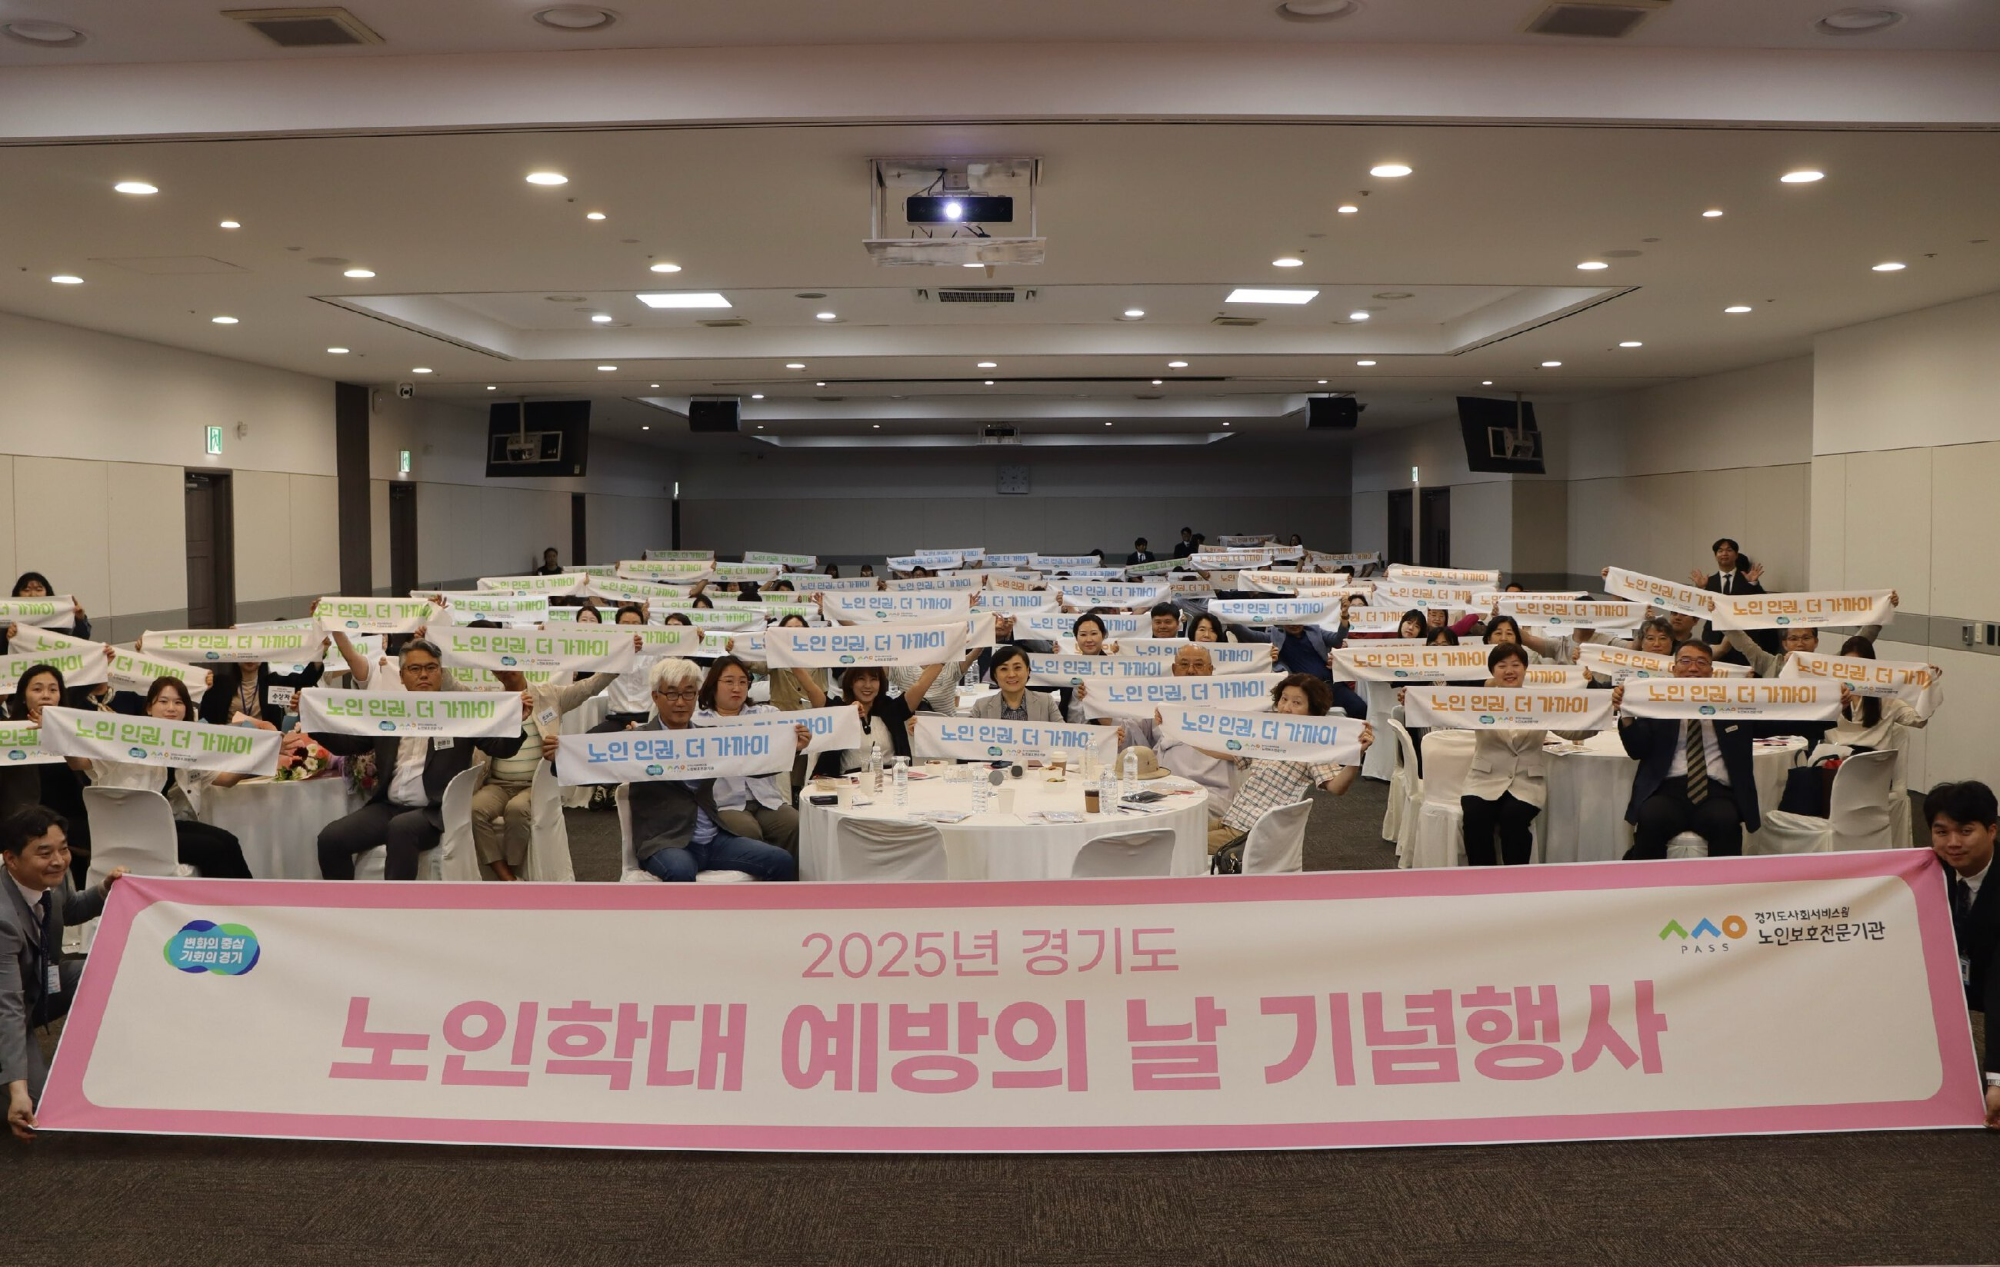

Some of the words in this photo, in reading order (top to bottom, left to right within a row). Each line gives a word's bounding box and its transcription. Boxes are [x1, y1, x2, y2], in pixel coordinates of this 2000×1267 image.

[667, 564, 676, 572] 더
[677, 564, 702, 572] 가까이
[1402, 569, 1420, 578] 노인
[1448, 570, 1458, 580] 더
[1460, 572, 1488, 582] 가까이
[536, 580, 545, 588] 더
[549, 577, 575, 588] 가까이
[800, 582, 816, 590] 노인
[848, 580, 870, 588] 가까이
[898, 582, 914, 592] 노인
[937, 580, 944, 588] 더
[948, 578, 972, 588] 가까이
[1252, 574, 1270, 584] 노인
[1296, 576, 1305, 586] 더
[1308, 577, 1336, 586] 가까이
[601, 581, 618, 591] 노인
[642, 586, 650, 595] 더
[654, 587, 679, 598] 가까이
[1062, 585, 1082, 596] 노인
[1086, 586, 1110, 596] 인권,
[1112, 586, 1122, 596] 더
[1126, 586, 1157, 598] 가까이
[1390, 587, 1410, 598] 노인
[1412, 588, 1435, 599] 인권,
[1438, 588, 1448, 600] 더
[1624, 576, 1648, 592] 노인
[1650, 583, 1675, 599] 인권,
[1679, 590, 1692, 603] 더
[498, 600, 508, 612] 더
[515, 600, 546, 612] 가까이
[842, 597, 866, 610] 노인
[869, 597, 897, 610] 인권,
[900, 598, 912, 610] 더
[916, 598, 952, 610] 가까이
[992, 596, 1004, 606] 더
[1007, 596, 1042, 607] 가까이
[1222, 602, 1244, 614] 노인
[1248, 602, 1273, 615] 인권,
[1276, 603, 1288, 614] 더
[1290, 602, 1324, 615] 가까이
[1516, 602, 1539, 614] 노인
[1542, 603, 1571, 616] 인권,
[1574, 604, 1587, 616] 더
[1590, 605, 1628, 617] 가까이
[1732, 602, 1762, 616] 노인
[1767, 600, 1802, 615] 인권,
[1806, 599, 1822, 613] 더
[1827, 596, 1872, 612] 가까이
[338, 604, 372, 618] 인권,
[376, 604, 391, 618] 더
[710, 613, 720, 622] 더
[722, 612, 752, 622] 가까이
[1366, 612, 1376, 622] 더
[1030, 618, 1054, 630] 노인
[163, 635, 194, 649] 노인
[198, 635, 232, 650] 인권,
[236, 635, 252, 649] 더
[257, 634, 302, 649] 가까이
[642, 630, 680, 644] 가까이
[706, 636, 716, 647] 더
[792, 636, 826, 652] 노인
[832, 636, 869, 652] 인권,
[874, 634, 890, 650] 더
[896, 630, 945, 650] 가까이
[452, 636, 486, 652] 노인
[492, 636, 530, 654] 인권,
[536, 638, 553, 655] 더
[558, 639, 608, 656] 가까이
[116, 656, 132, 672] 더
[1354, 654, 1382, 668] 노인
[1385, 654, 1419, 668] 인권,
[1422, 652, 1438, 667] 더
[1442, 651, 1487, 667] 가까이
[1598, 651, 1628, 666] 노인
[1632, 656, 1662, 672] 인권,
[11, 660, 28, 677] 더
[1031, 660, 1058, 674] 노인
[1064, 660, 1096, 676] 인권,
[1100, 662, 1114, 676] 더
[1118, 662, 1161, 676] 가까이
[1796, 657, 1828, 676] 노인
[1832, 663, 1870, 682] 인권,
[1876, 667, 1893, 684] 더
[1108, 686, 1142, 702] 노인
[1147, 685, 1186, 702] 인권,
[1192, 684, 1208, 700] 더
[1212, 680, 1264, 698] 가까이
[1648, 684, 1684, 702] 노인
[1690, 685, 1732, 704] 인권,
[1737, 686, 1754, 703] 더
[1762, 686, 1816, 704] 가까이
[326, 698, 363, 716] 노인
[368, 700, 411, 718] 인권,
[416, 700, 434, 718] 더
[440, 700, 494, 718] 가까이
[1432, 694, 1466, 712] 노인
[1470, 695, 1510, 712] 인권,
[1514, 696, 1532, 712] 더
[1537, 696, 1588, 714] 가까이
[76, 718, 116, 741] 노인
[121, 724, 164, 747] 인권,
[172, 729, 192, 750] 더
[197, 732, 252, 755] 가까이
[941, 724, 974, 742] 노인
[978, 726, 1018, 744] 인권,
[1022, 728, 1040, 746] 더
[1181, 712, 1215, 733] 노인
[1218, 716, 1256, 738] 인권,
[1262, 720, 1280, 740] 더
[1284, 722, 1338, 746] 가까이
[0, 729, 42, 748] 인권,
[588, 741, 628, 764] 노인
[634, 740, 680, 760] 인권,
[686, 738, 704, 758] 더
[711, 735, 769, 757] 가까이
[1755, 907, 1850, 924] 경기도사회서비스원
[1758, 921, 1885, 946] 노인보호전문기관
[183, 937, 218, 950] 변화의
[220, 938, 246, 950] 중심
[1681, 943, 1729, 954] PASS
[180, 950, 218, 963] 기회의
[219, 952, 242, 964] 경기
[801, 930, 997, 978] 2025년
[1022, 927, 1179, 976] 경기도
[328, 997, 747, 1091] 노인학대
[781, 1000, 1088, 1094] 예방의
[1127, 997, 1227, 1091] 날
[1260, 980, 1668, 1087] 기념행사
